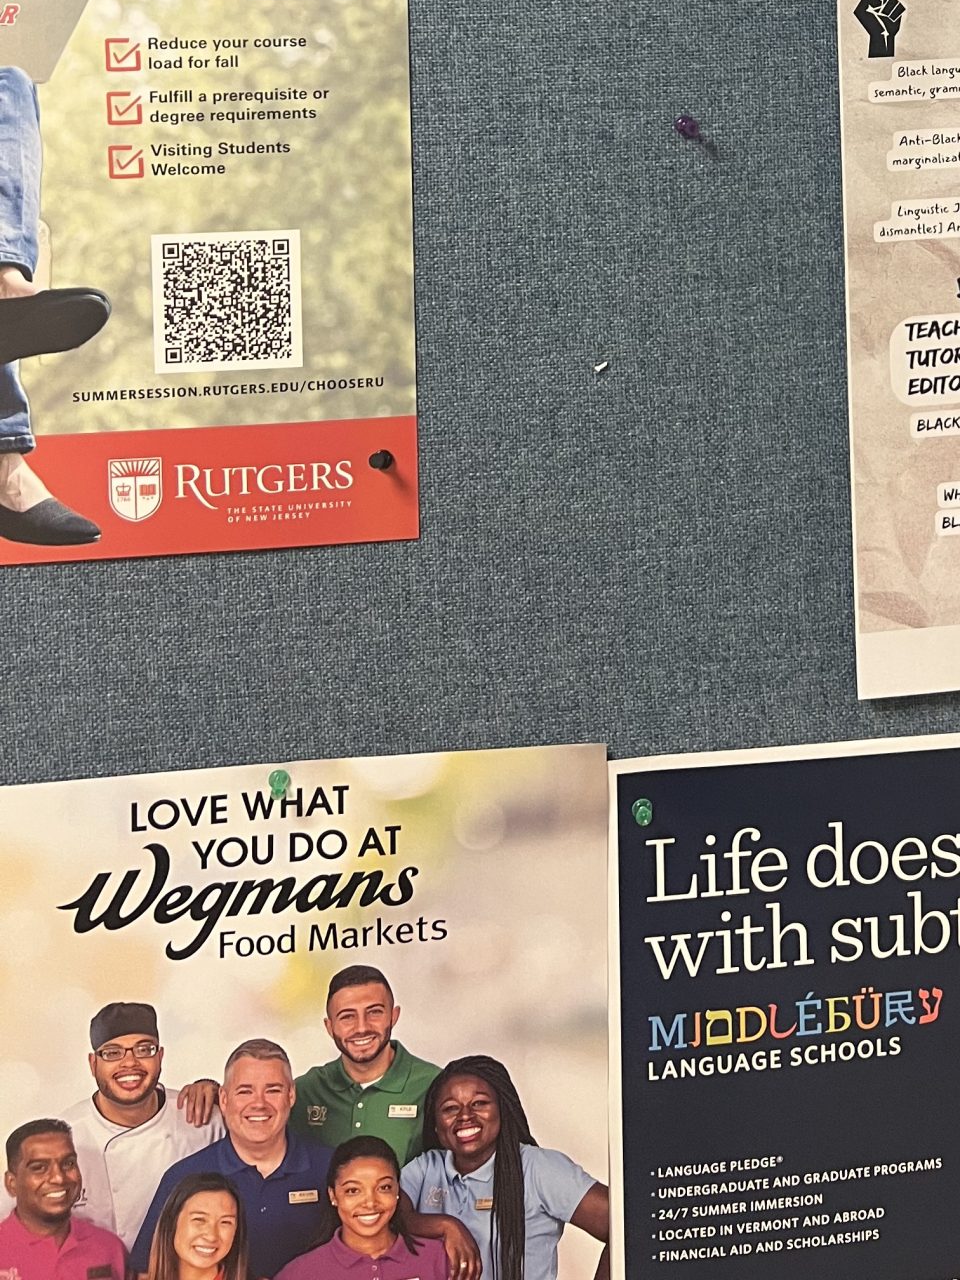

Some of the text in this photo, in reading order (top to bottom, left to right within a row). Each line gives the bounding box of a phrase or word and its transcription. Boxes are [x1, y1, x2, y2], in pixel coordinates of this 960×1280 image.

[148, 37, 307, 52] Reduce your course
[149, 55, 238, 69] load for fall
[150, 141, 290, 158] Visiting Students
[151, 163, 225, 176] Welcome
[73, 377, 383, 402] SUMMERSESSION.RUTGERS.EDU/CHOOSERU
[174, 461, 353, 509] RUTGERS
[131, 784, 350, 832] LOVE WHAT
[192, 825, 401, 870] YOU DO AT
[646, 828, 788, 902] Life
[57, 842, 419, 960] Wegmans
[220, 917, 447, 958] Food Markets
[644, 902, 814, 980] with
[648, 1037, 901, 1080] LANGUAGE SCHOOLS
[658, 1162, 726, 1178] LANGUAGE
[659, 1194, 823, 1220] 24/7 SUMMER IMMERSION
[659, 1229, 879, 1261] FINANCIAL AID AND SCHOLARSHIPS
